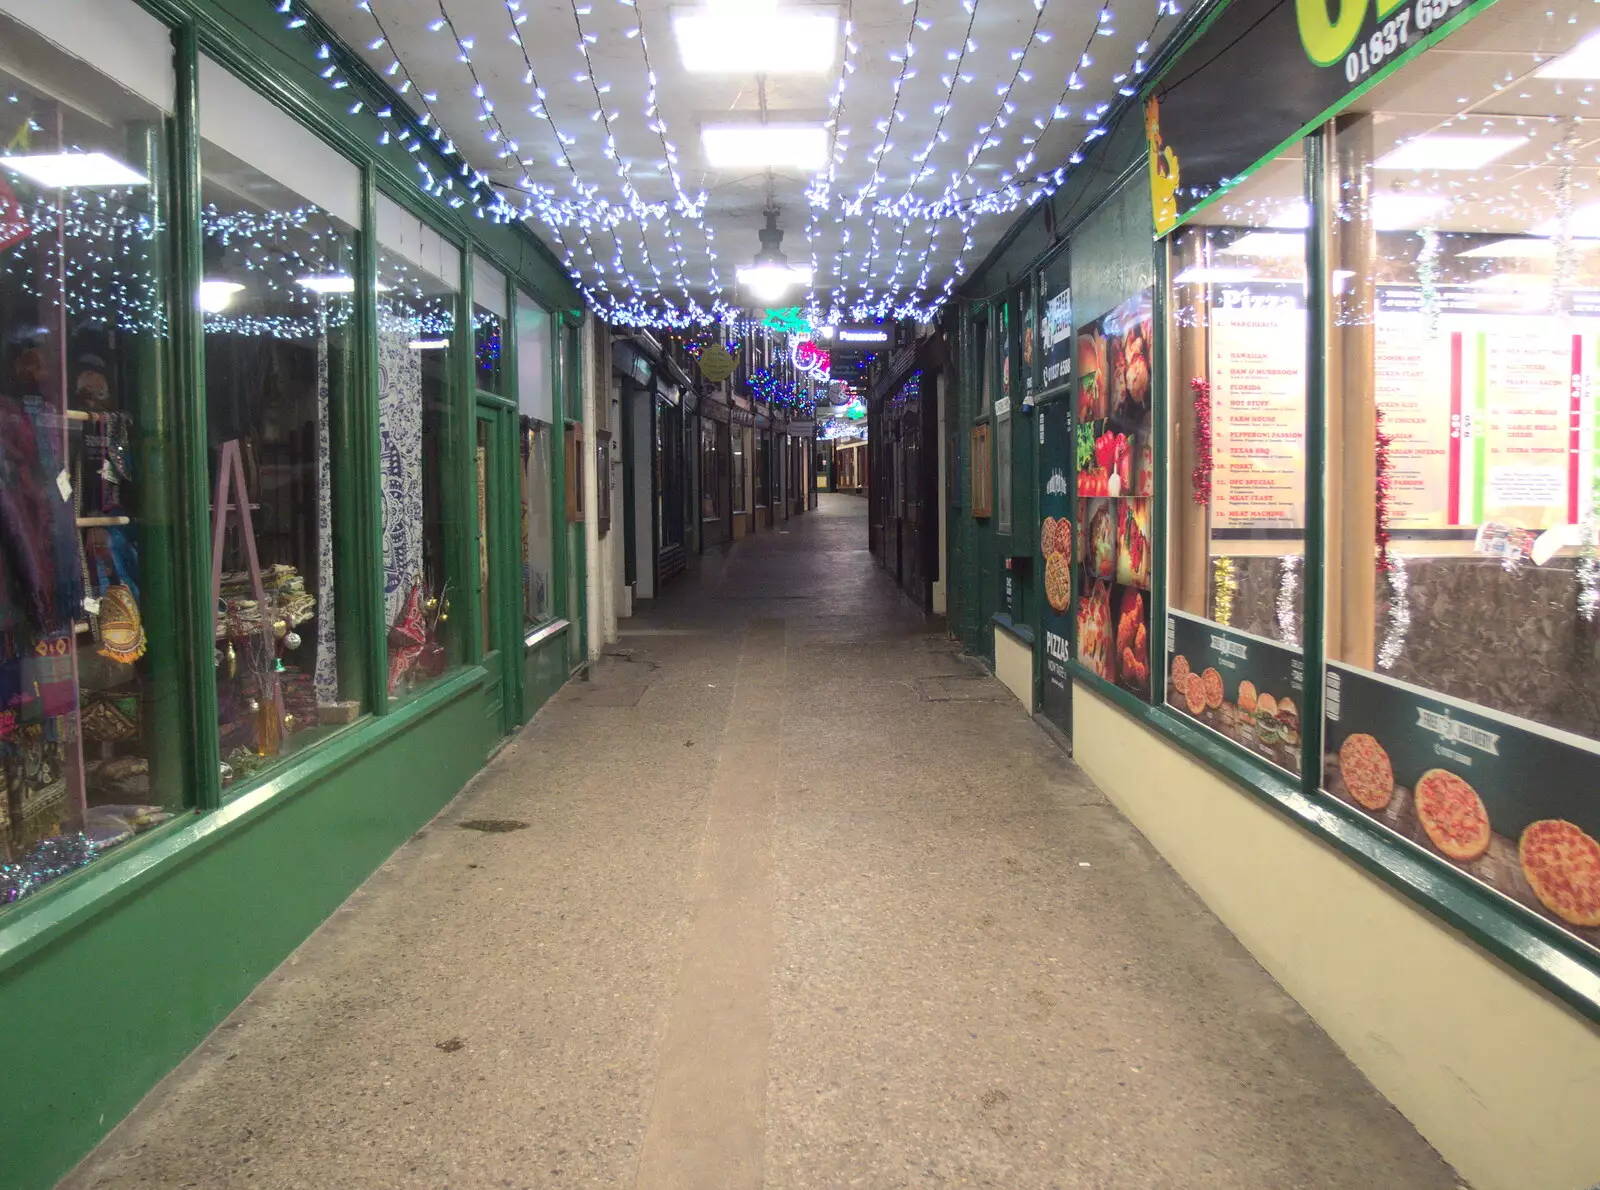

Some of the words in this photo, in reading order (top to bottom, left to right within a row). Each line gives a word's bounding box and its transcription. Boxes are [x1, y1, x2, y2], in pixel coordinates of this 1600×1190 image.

[1345, 8, 1410, 82] 01837
[1415, 0, 1463, 29] 65
[1221, 287, 1297, 310] Pizza
[840, 331, 887, 341] Panasonic
[1046, 630, 1069, 662] PIZZAS
